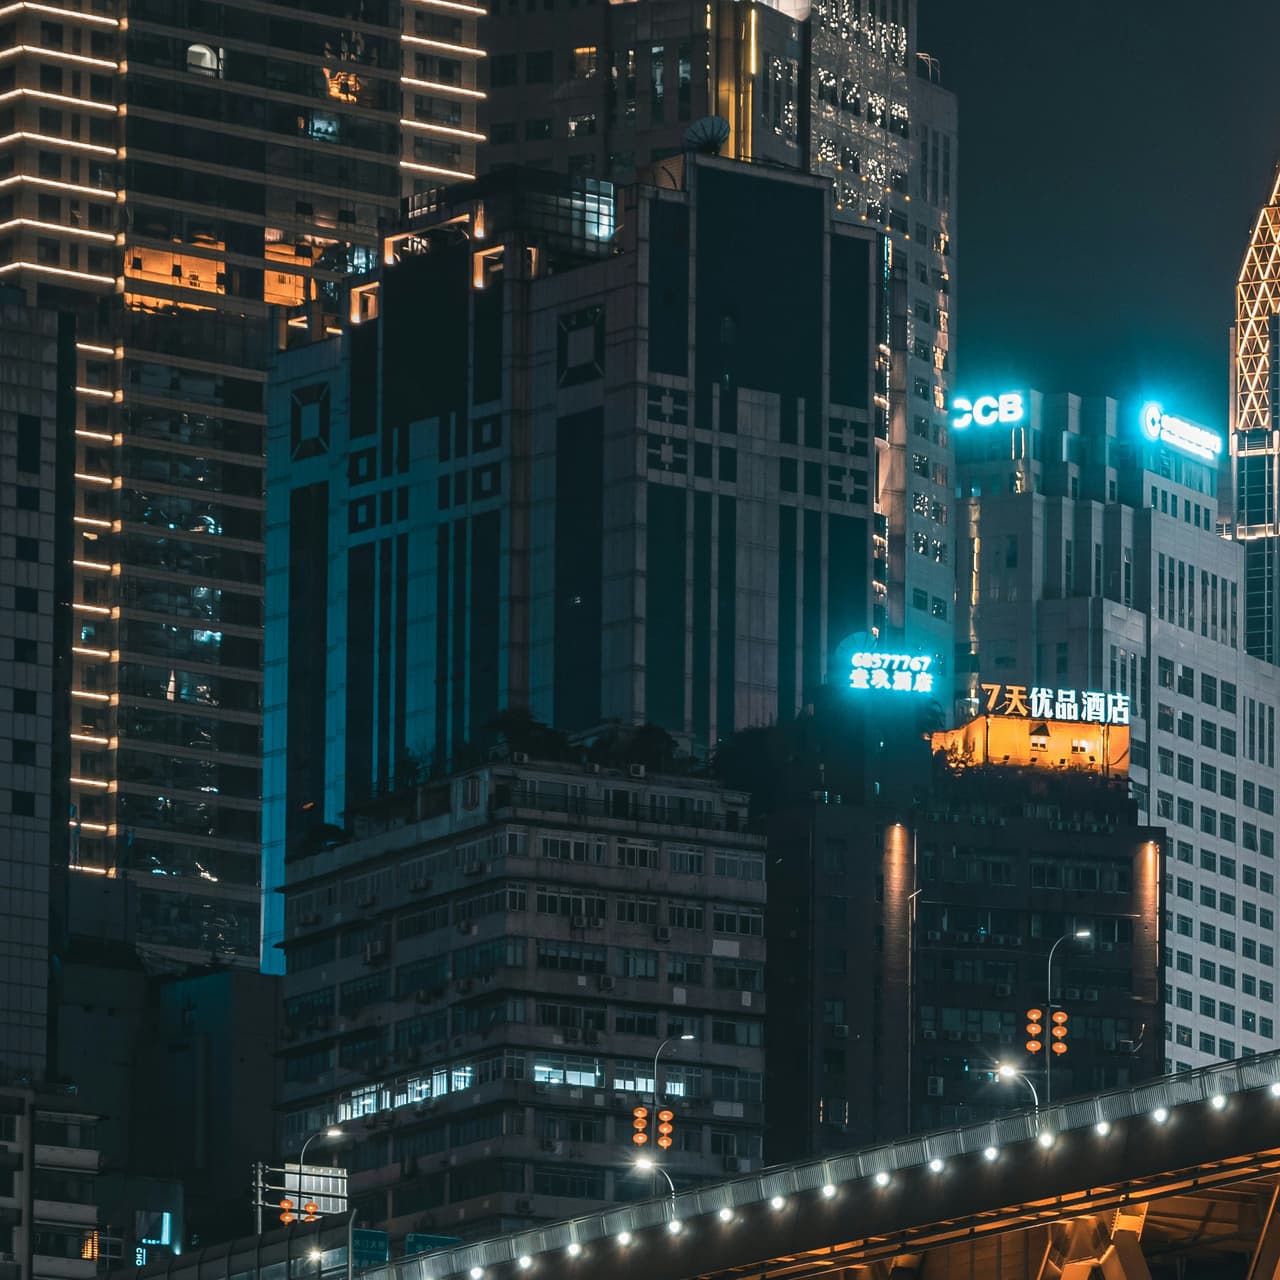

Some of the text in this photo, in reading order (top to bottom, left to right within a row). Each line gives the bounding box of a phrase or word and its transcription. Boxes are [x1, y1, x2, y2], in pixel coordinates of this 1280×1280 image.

[979, 683, 1131, 725] 7天优品酒店
